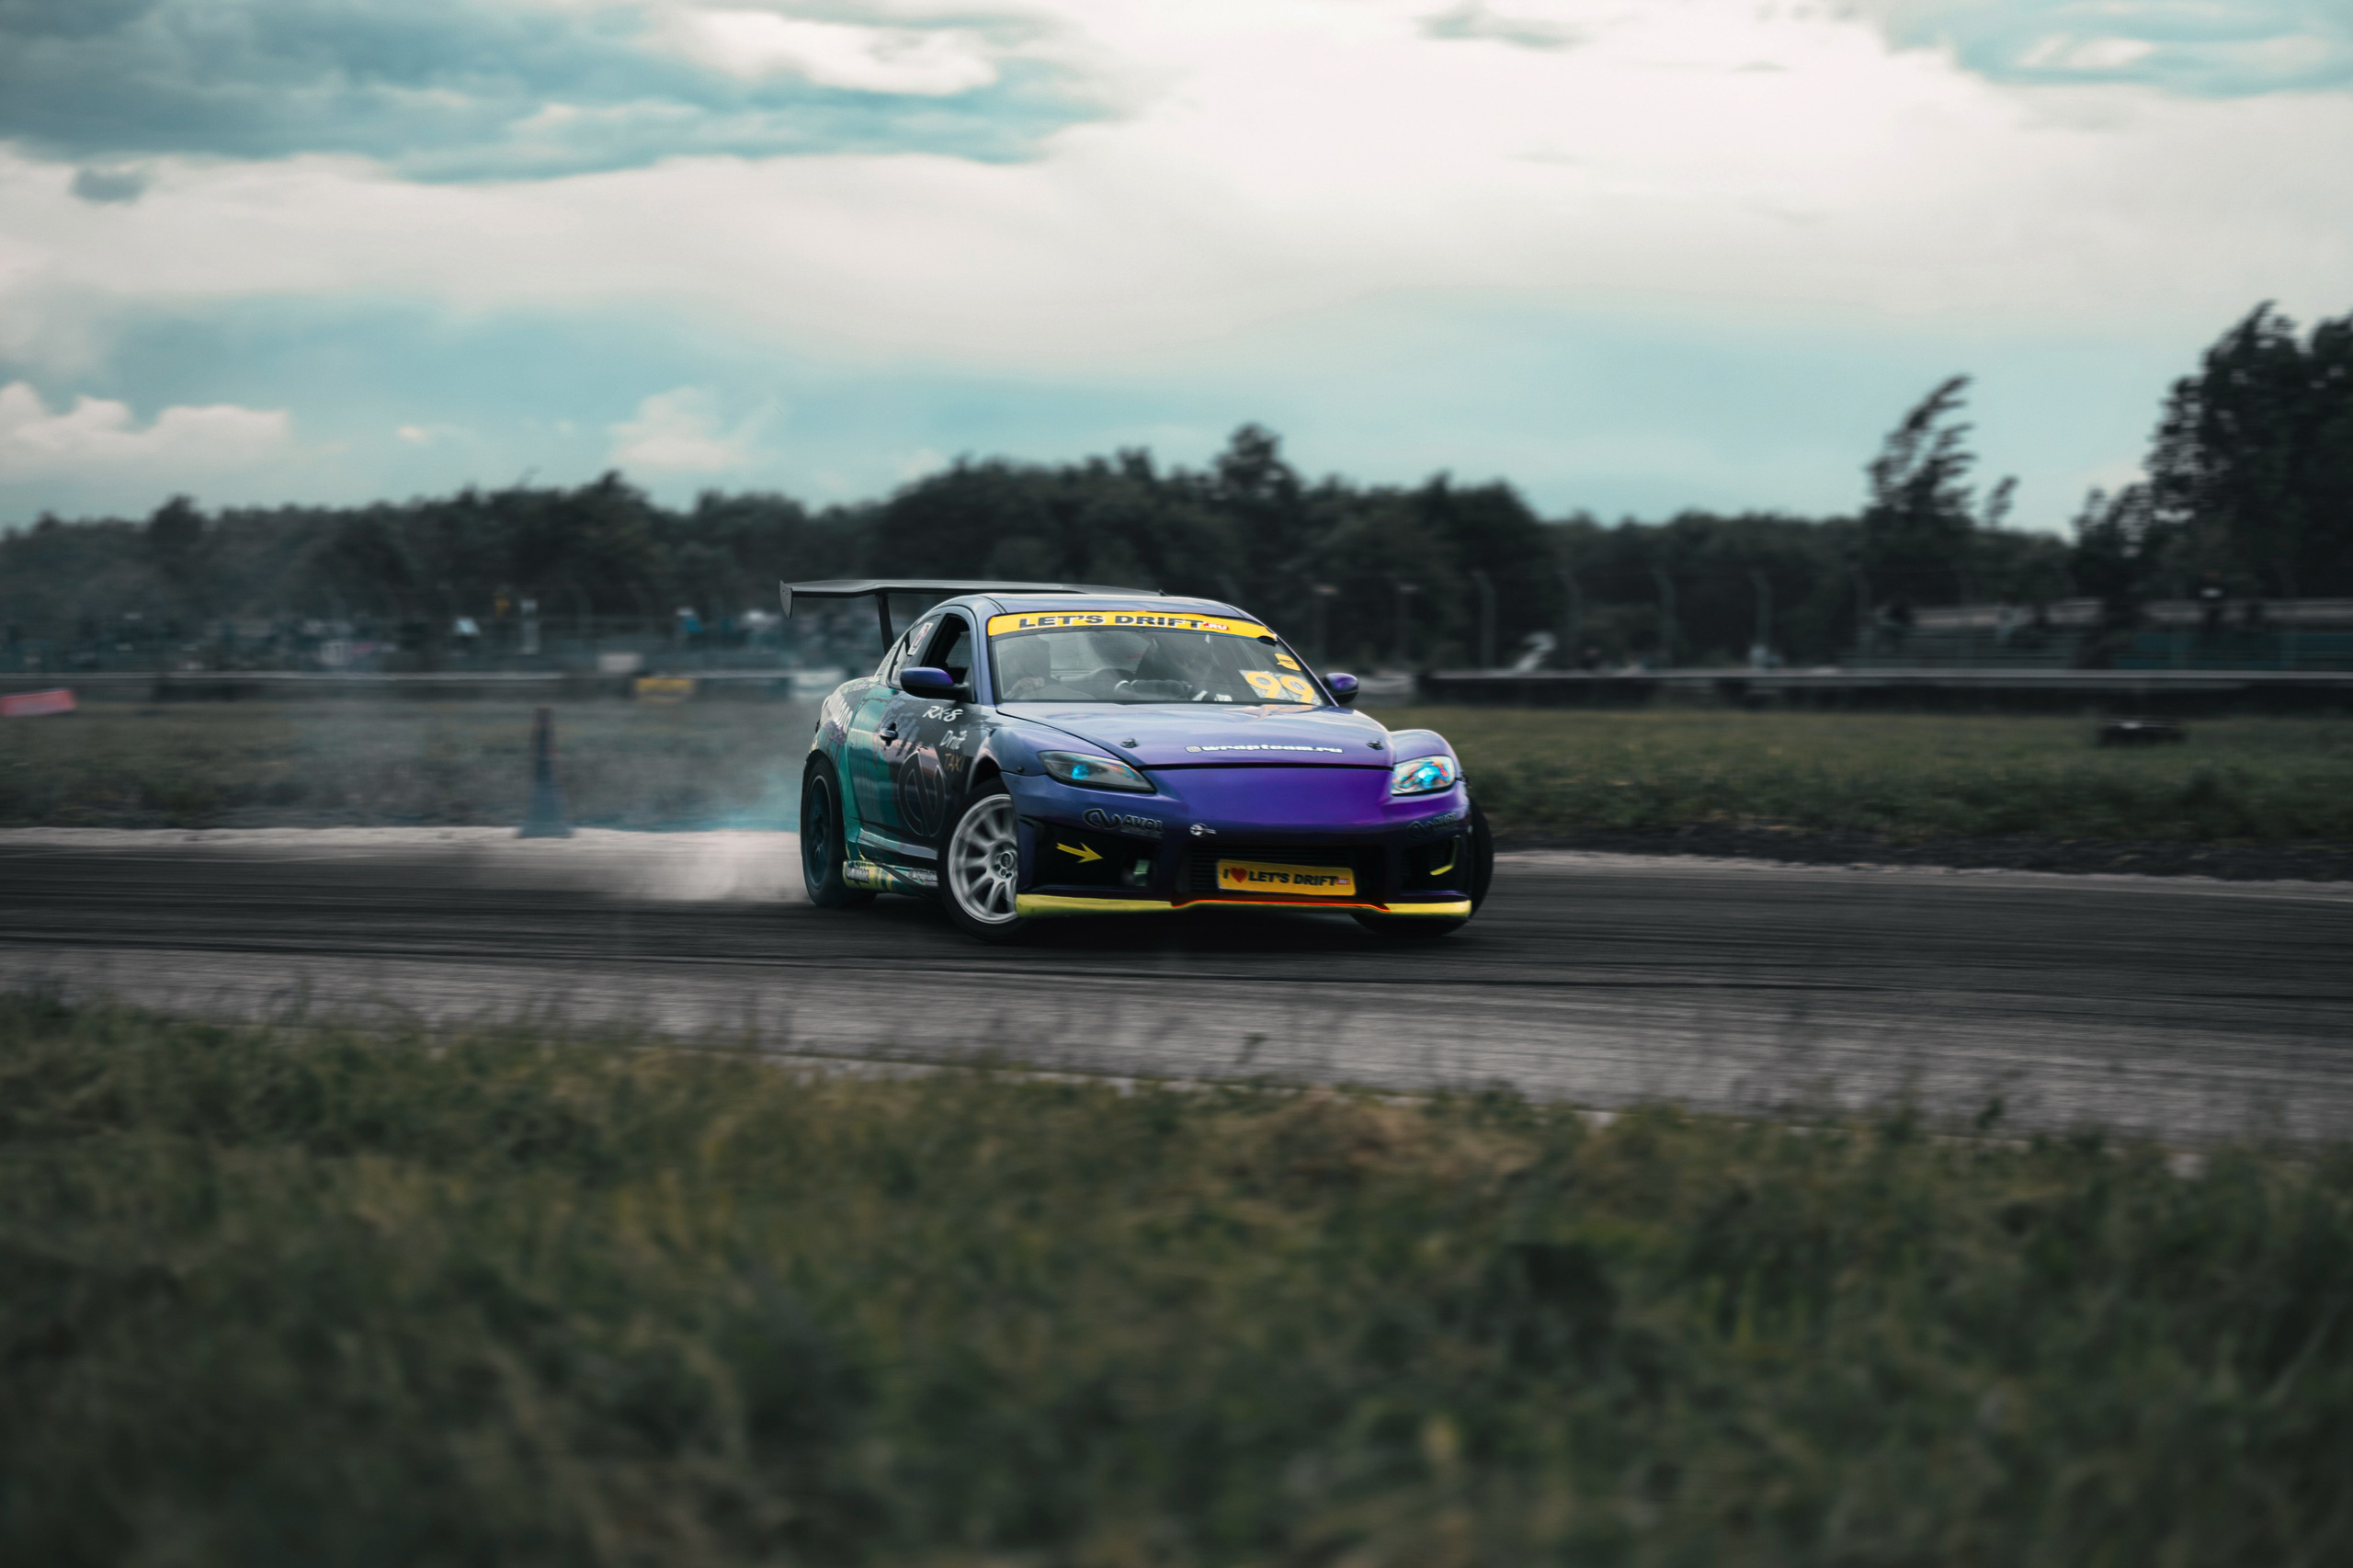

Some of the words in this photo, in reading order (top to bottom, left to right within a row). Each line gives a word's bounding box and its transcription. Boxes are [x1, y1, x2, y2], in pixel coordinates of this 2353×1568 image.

[1018, 614, 1106, 629] LET'S
[1245, 671, 1315, 703] 99
[922, 705, 963, 722] RX-8
[944, 753, 965, 773] TAXI
[1223, 869, 1230, 880] I
[1247, 870, 1290, 883] LET'S
